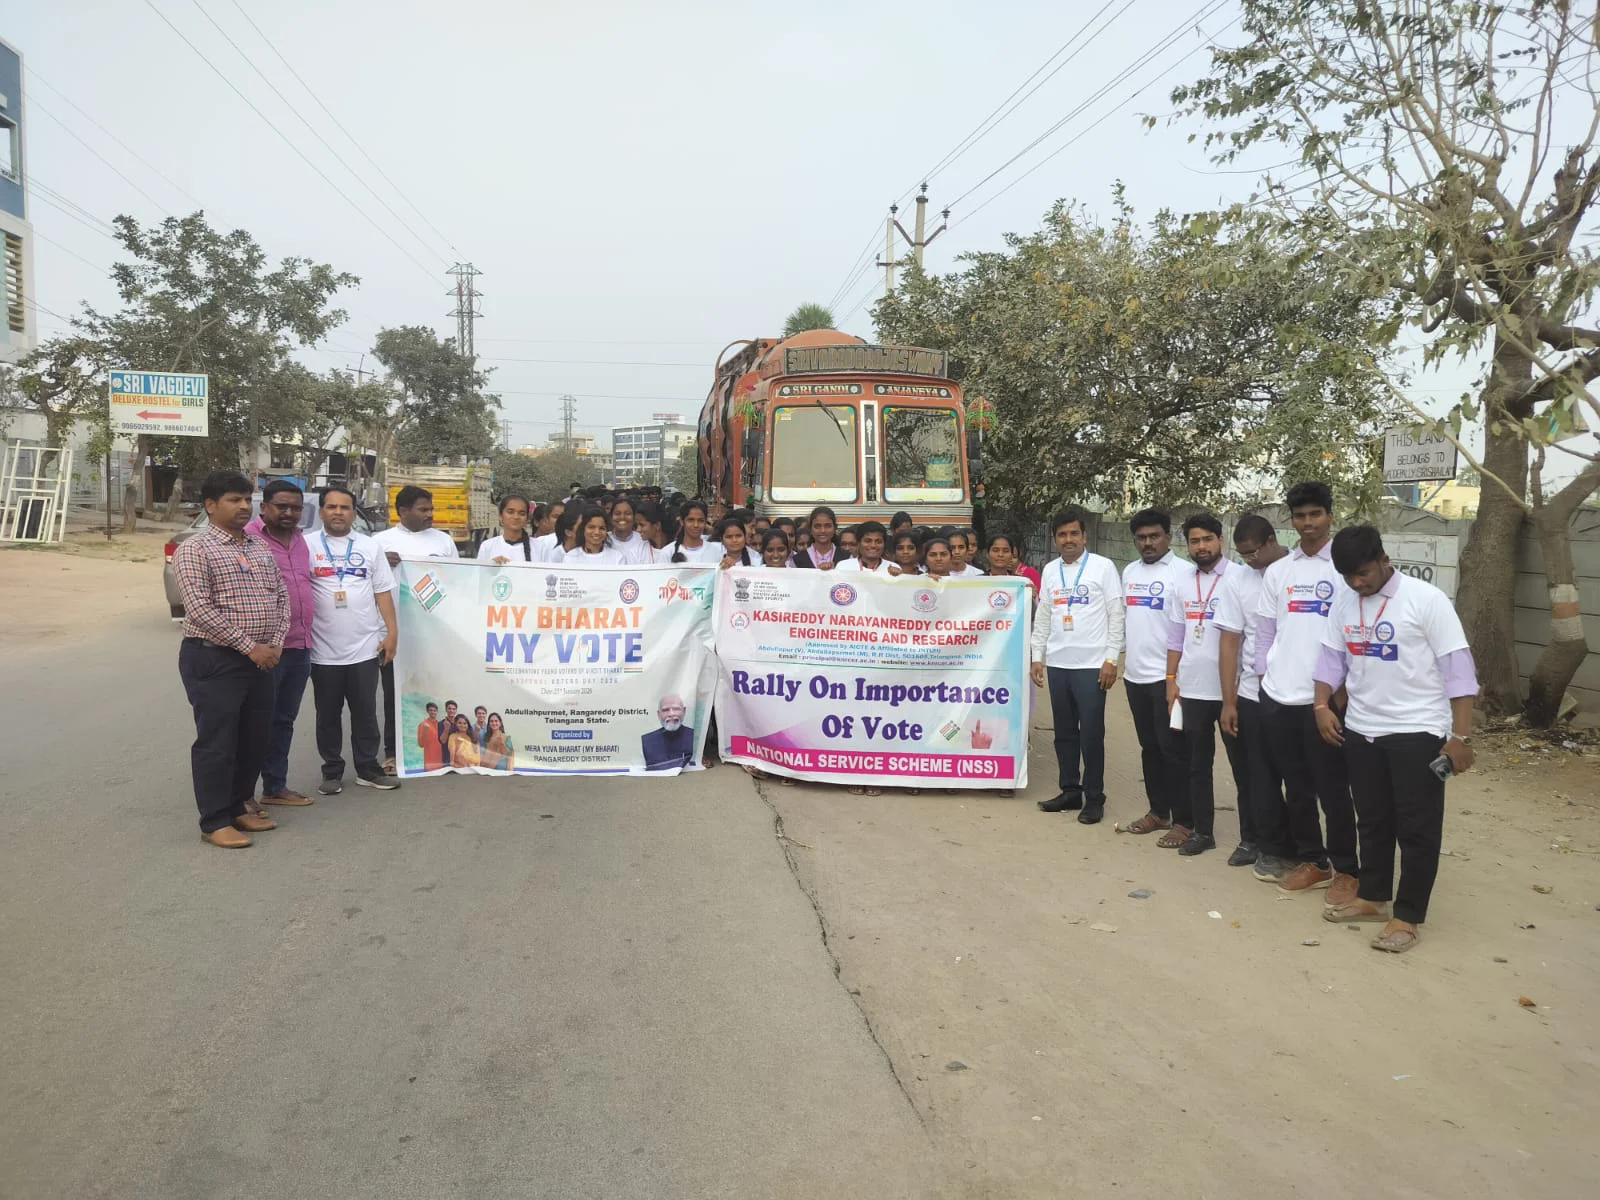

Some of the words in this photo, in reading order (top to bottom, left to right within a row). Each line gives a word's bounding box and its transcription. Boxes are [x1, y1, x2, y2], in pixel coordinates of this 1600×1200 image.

[123, 374, 145, 393] SRI
[149, 376, 205, 397] VAGDEVI
[112, 394, 141, 404] DELUXE
[181, 397, 204, 407] GIRLS
[1391, 431, 1413, 448] THIS
[1397, 452, 1430, 466] BELONGS
[1434, 451, 1445, 463] TO
[487, 605, 528, 628] MY
[537, 606, 643, 630] BHARAT
[753, 610, 826, 625] KASIREDDY
[829, 614, 931, 632] NARAYANREDDY
[935, 619, 992, 631] COLLEGE
[995, 620, 1013, 631] OF
[789, 626, 878, 643] ENGINEERING
[882, 632, 908, 645] AND
[912, 634, 979, 646] RESEARCH
[485, 632, 541, 664] MY
[732, 670, 802, 702] Rally
[809, 675, 847, 701] On
[854, 677, 1010, 707] Importance
[504, 708, 568, 718] Abdullahpurmet,
[570, 708, 616, 718] Rangareddy
[618, 707, 649, 716] District,
[544, 717, 585, 725] Telangana
[586, 717, 610, 725] State.
[553, 731, 582, 740] Organized
[583, 731, 591, 740] by
[822, 714, 854, 739] Of
[861, 716, 923, 741] Vote
[543, 745, 558, 753] YUVA
[559, 745, 581, 753] BHARAT
[746, 739, 814, 768] NATIONAL
[818, 754, 883, 771] SERVICE
[888, 757, 953, 774] SCHEME
[957, 759, 999, 776] (NSS)
[534, 755, 579, 763] RANGAREDDY
[581, 755, 611, 763] DISTRICT
